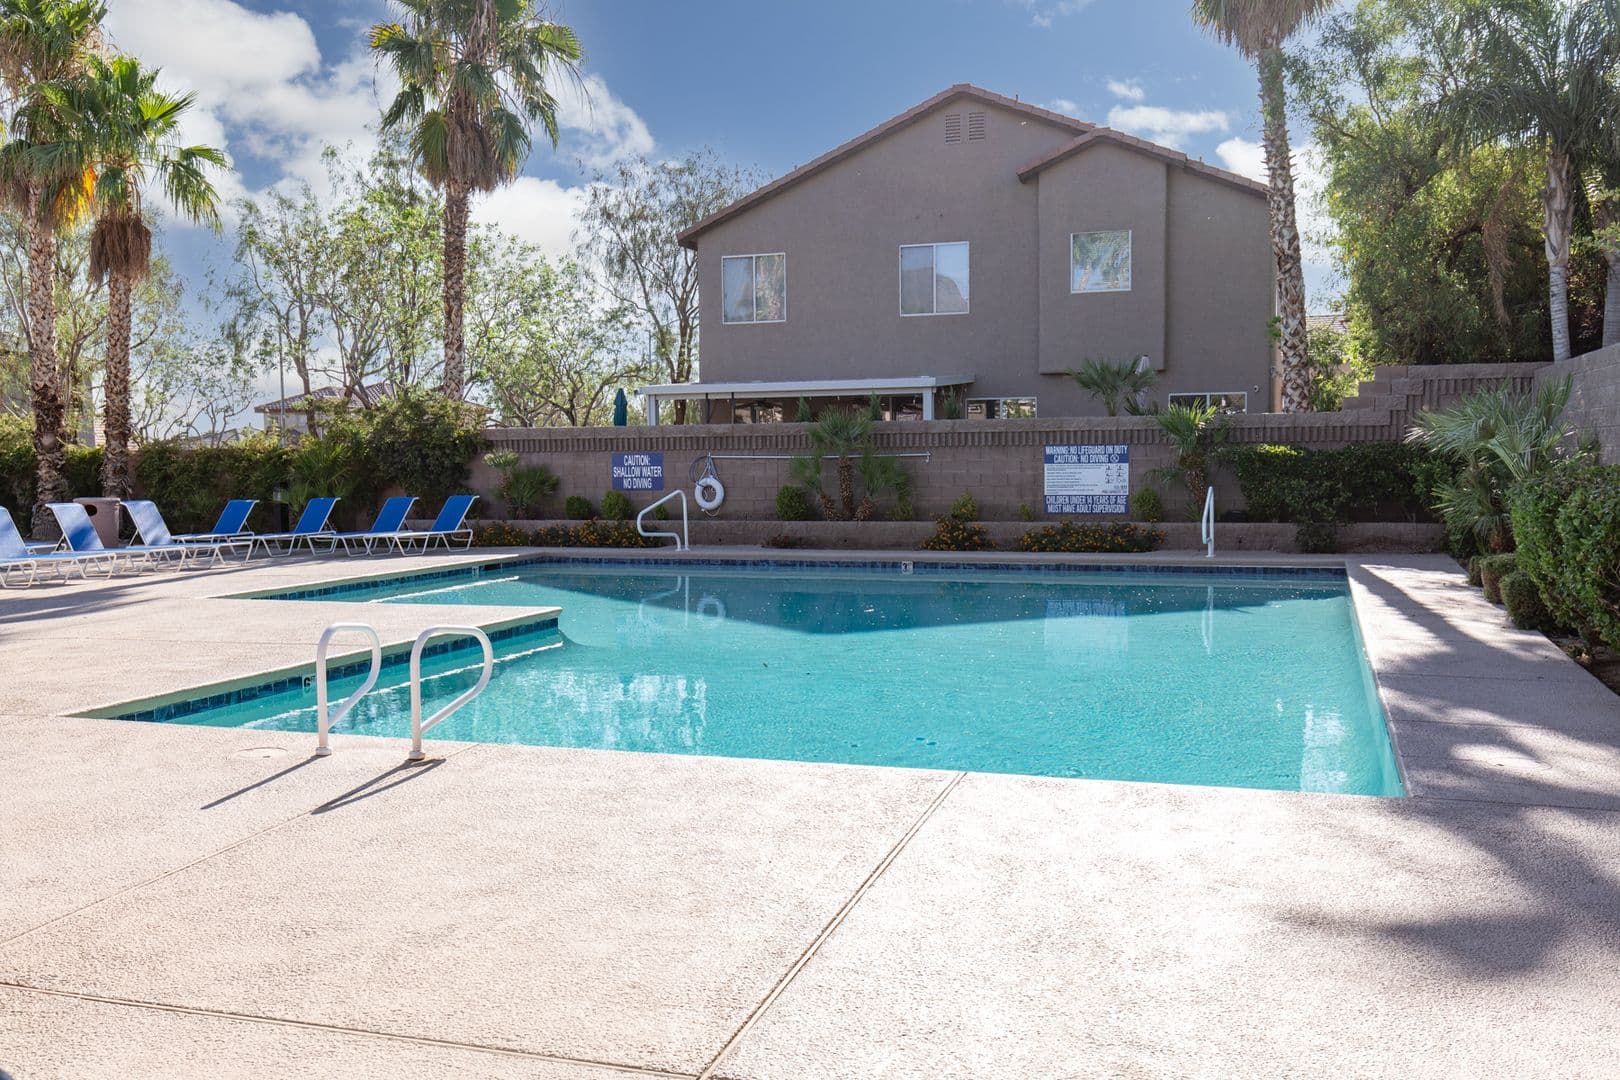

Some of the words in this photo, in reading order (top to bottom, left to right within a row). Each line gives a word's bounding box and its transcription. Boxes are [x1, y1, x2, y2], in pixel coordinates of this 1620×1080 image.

[1070, 446, 1077, 454] NO
[1078, 446, 1105, 454] LIFEGUARD
[1106, 446, 1113, 454] ON
[1114, 446, 1128, 454] DUTY
[624, 455, 650, 466] CAUTION:
[1054, 455, 1079, 463] CAUTION:
[1081, 455, 1088, 463] NO
[1090, 454, 1108, 463] DIVING
[613, 466, 641, 477] SHALLOW
[642, 466, 662, 477] WATER
[624, 478, 631, 488] NO
[633, 478, 652, 488] DIVING
[1046, 496, 1069, 504] CHILDREN
[1070, 496, 1086, 504] UNDER
[1087, 496, 1092, 504] 14
[1093, 496, 1109, 504] YEARS
[1110, 496, 1116, 504] OF
[1117, 496, 1127, 504] AGE
[1048, 504, 1062, 512] MUST
[1063, 504, 1076, 512] HAVE
[1077, 504, 1091, 512] ADULT
[1093, 504, 1125, 512] SUPERVISION
